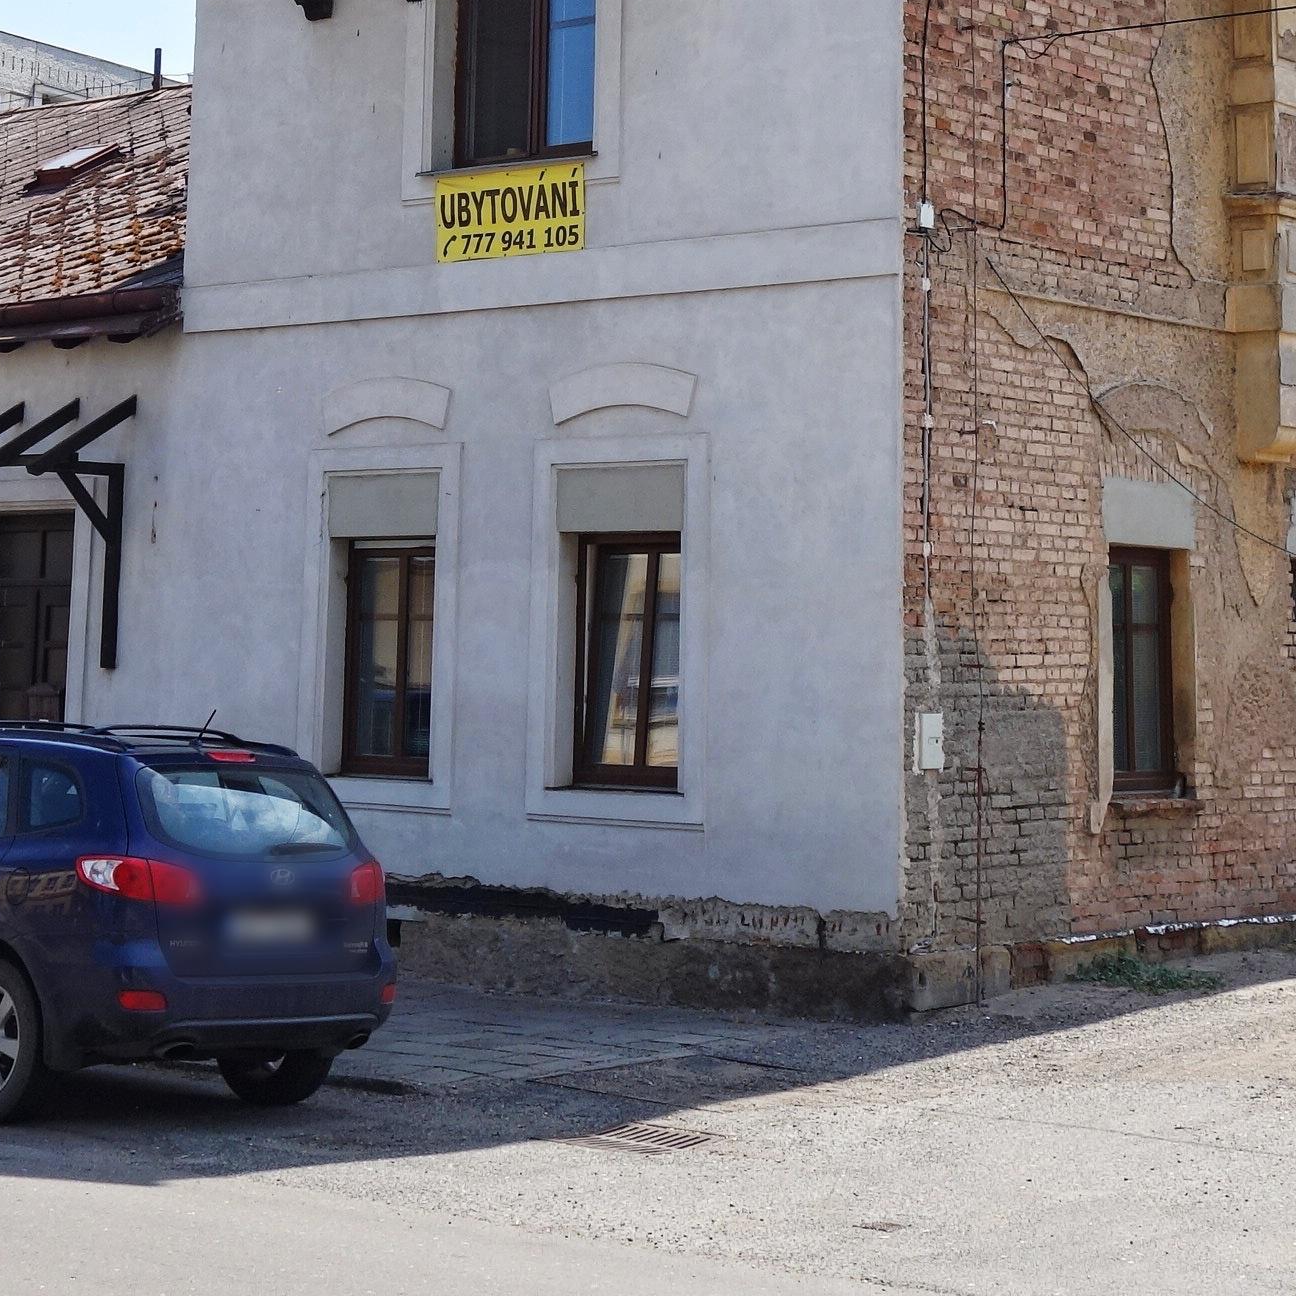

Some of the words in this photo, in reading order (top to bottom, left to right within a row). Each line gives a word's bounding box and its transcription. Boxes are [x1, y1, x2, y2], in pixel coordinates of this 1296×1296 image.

[440, 168, 580, 229] UBYTOVÁNÍ
[461, 232, 496, 255] 777
[501, 228, 536, 252] 941
[544, 224, 579, 248] 105
